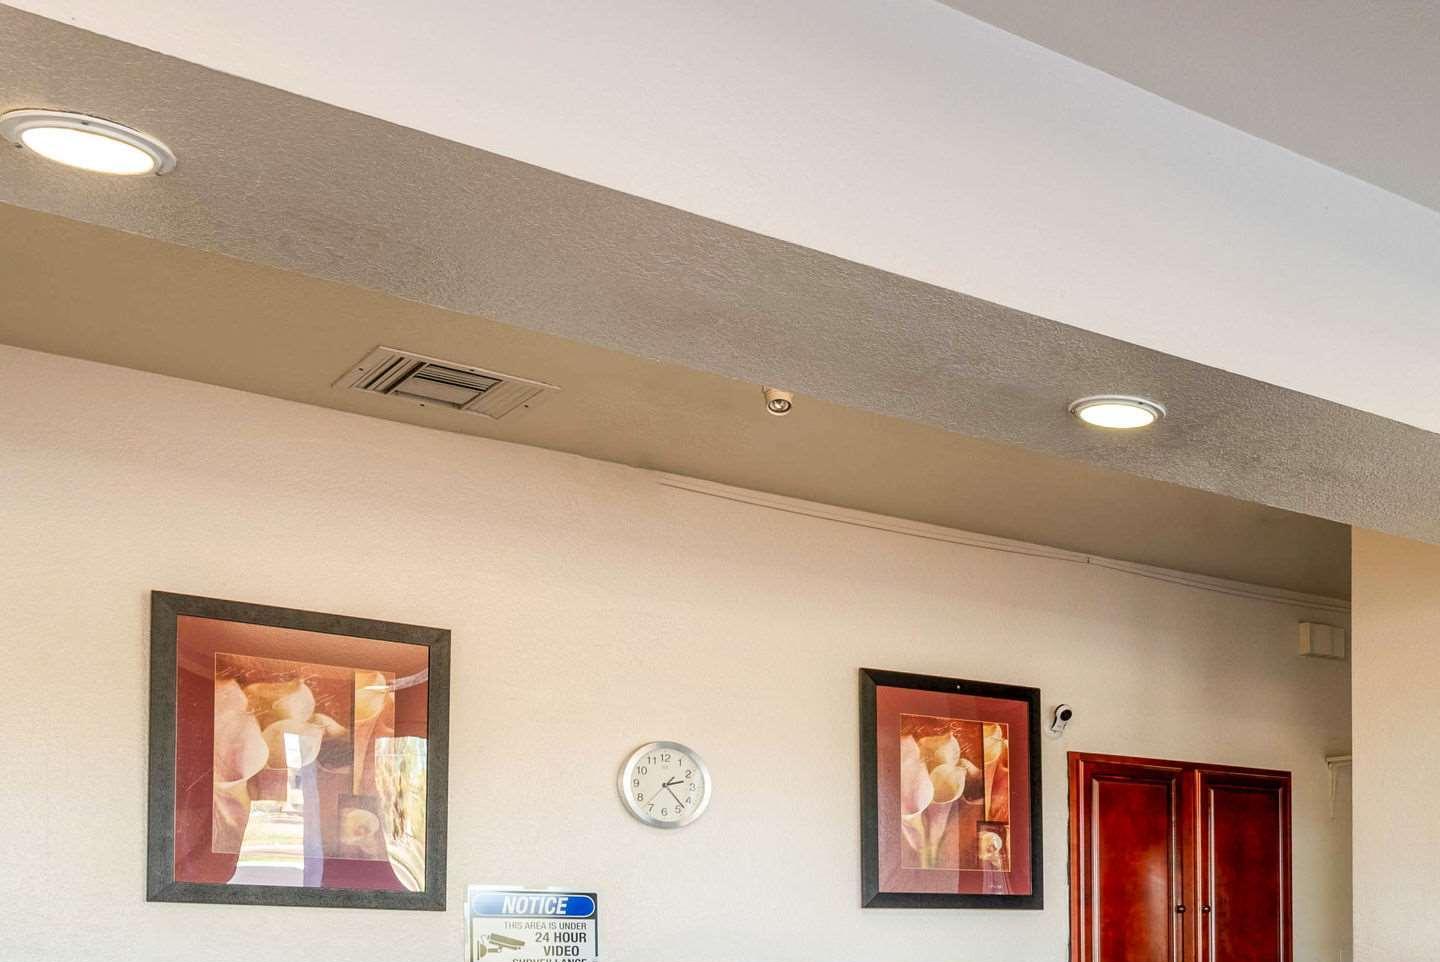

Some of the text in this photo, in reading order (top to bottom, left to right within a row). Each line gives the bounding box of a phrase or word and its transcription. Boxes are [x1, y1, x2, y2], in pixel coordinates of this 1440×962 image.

[647, 756, 657, 765] 11
[660, 754, 671, 762] 12
[637, 766, 647, 775] 10
[685, 770, 692, 778] 2
[633, 778, 640, 787] 9
[689, 783, 696, 791] 3
[637, 793, 644, 801] 8
[647, 803, 655, 812] 7
[661, 808, 668, 816] 6
[675, 805, 681, 813] 5
[502, 895, 569, 915] NOTICE
[504, 921, 587, 930] THIS AREA IS UNDER
[535, 932, 587, 943] 24 HOUR
[543, 945, 580, 957] VIDEO
